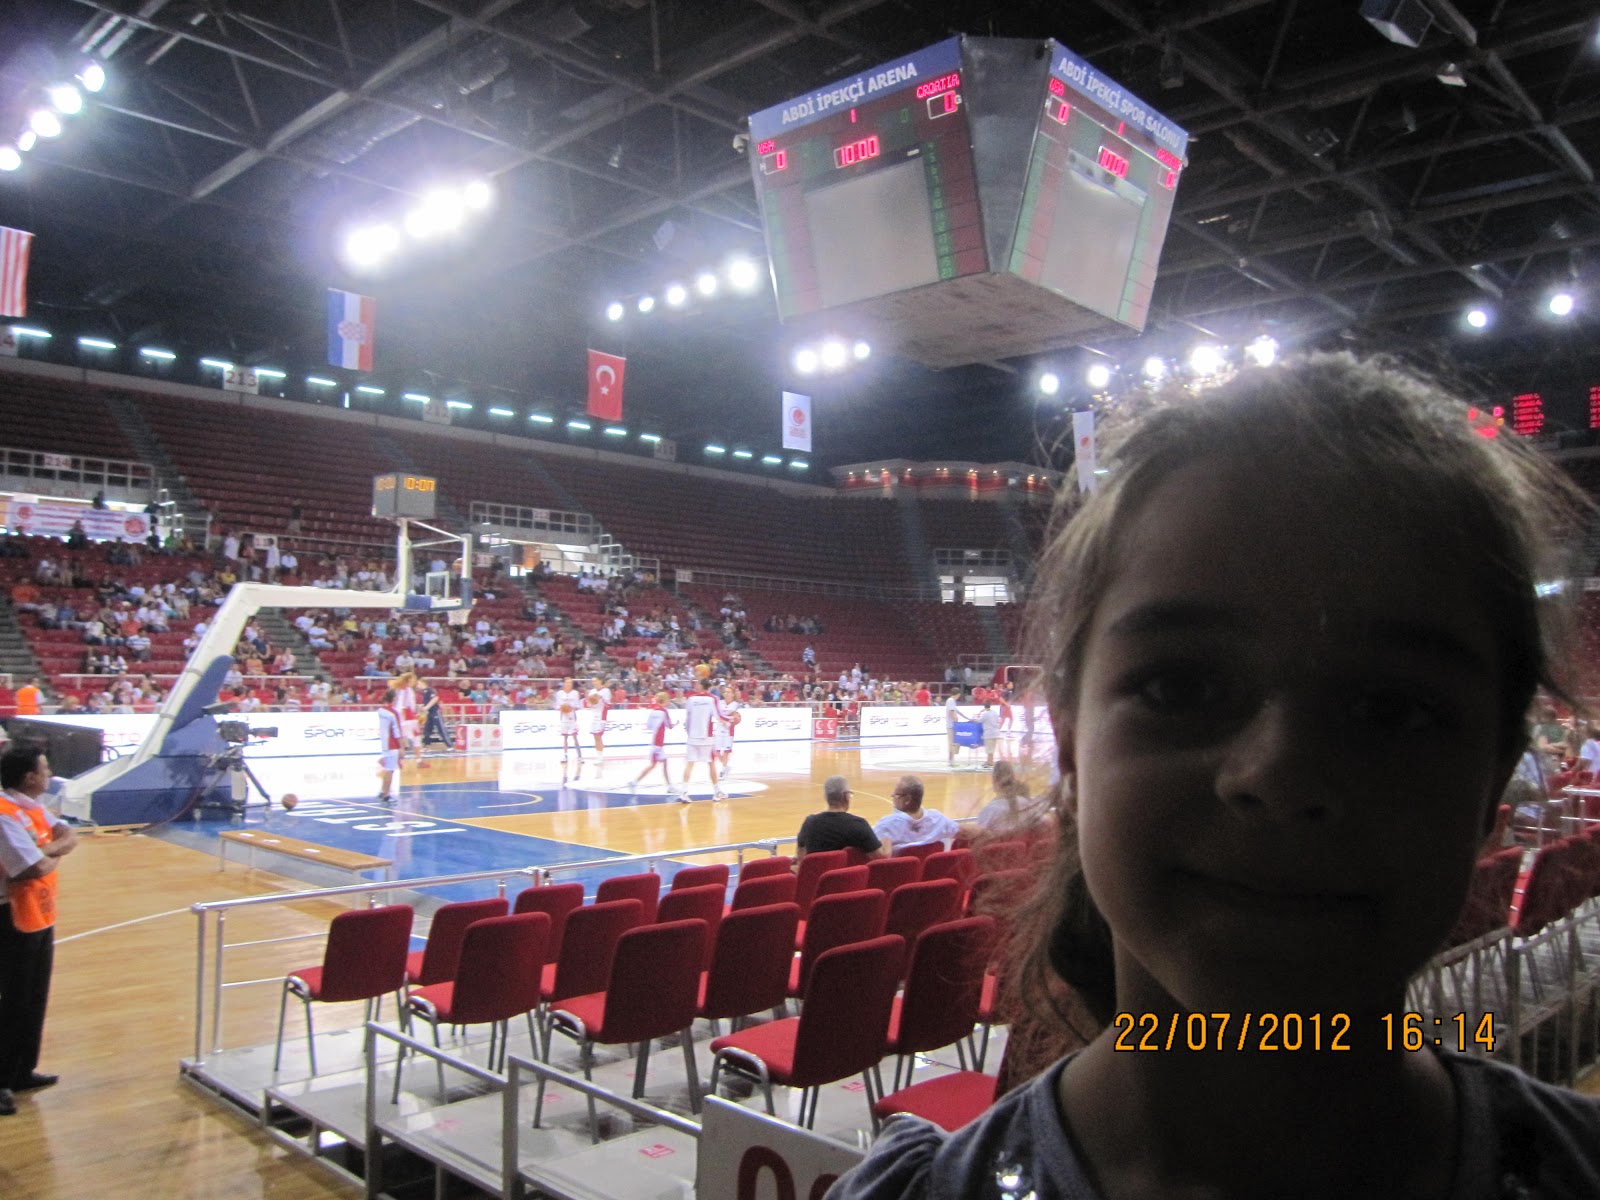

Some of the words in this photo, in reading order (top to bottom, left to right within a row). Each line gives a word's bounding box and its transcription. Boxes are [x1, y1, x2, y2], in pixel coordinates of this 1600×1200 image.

[782, 97, 815, 125] ABDİ
[816, 80, 866, 111] İPEKÇİ
[868, 62, 918, 94] ARENA
[916, 74, 960, 98] CROATIA
[1049, 77, 1065, 97] USA
[1058, 57, 1088, 85] ABDİ
[1086, 72, 1121, 109] İPEKÇİ
[1120, 99, 1146, 126] SPOR
[944, 90, 957, 113] 0
[1058, 101, 1070, 124] 0
[757, 139, 775, 155] USA
[776, 150, 787, 170] 0
[226, 370, 257, 387] 213
[304, 728, 345, 738] SPOR
[513, 725, 547, 734] SPOR
